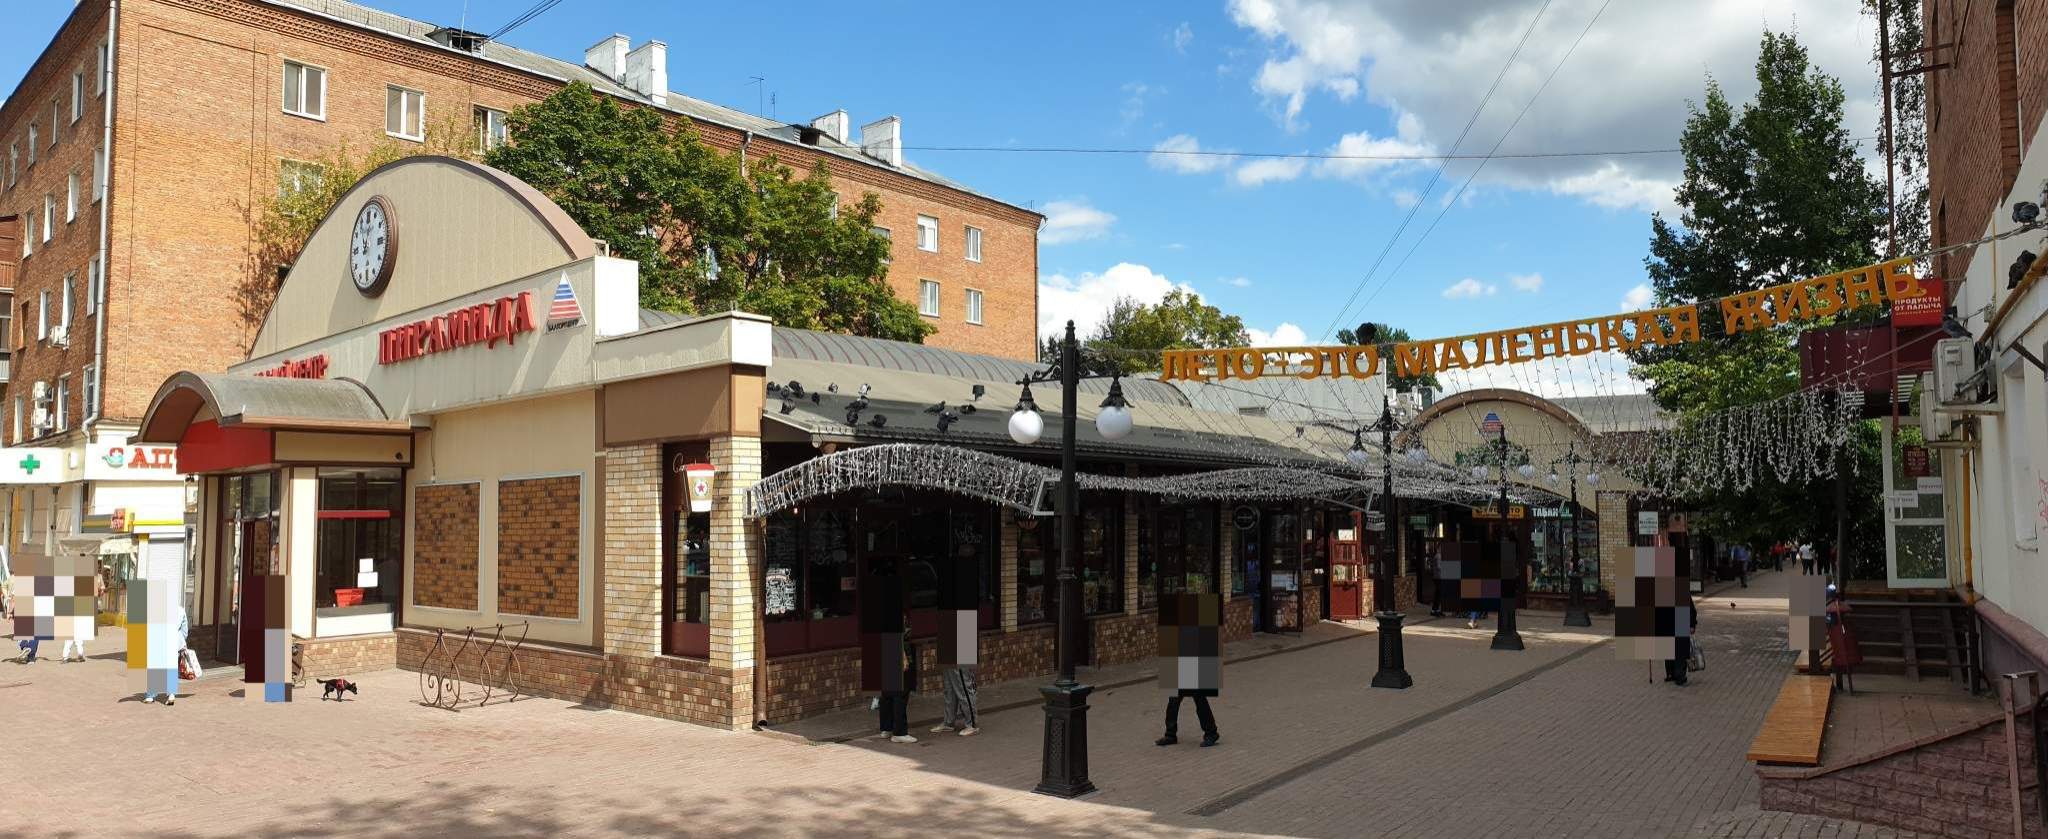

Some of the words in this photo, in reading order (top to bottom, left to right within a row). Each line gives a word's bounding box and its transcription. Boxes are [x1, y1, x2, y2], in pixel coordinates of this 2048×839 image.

[1159, 348, 1265, 382] ЛЕТО
[1298, 346, 1379, 380] ЭТО
[1394, 305, 1700, 377] МАЛЕНЬКАЯ
[1720, 258, 1919, 336] ЖИЗНЬ
[1894, 296, 1941, 305] ПРОДУКТЫ
[1907, 302, 1942, 311] ПАЛЫЧА
[379, 291, 535, 365] ПИРАМИДА
